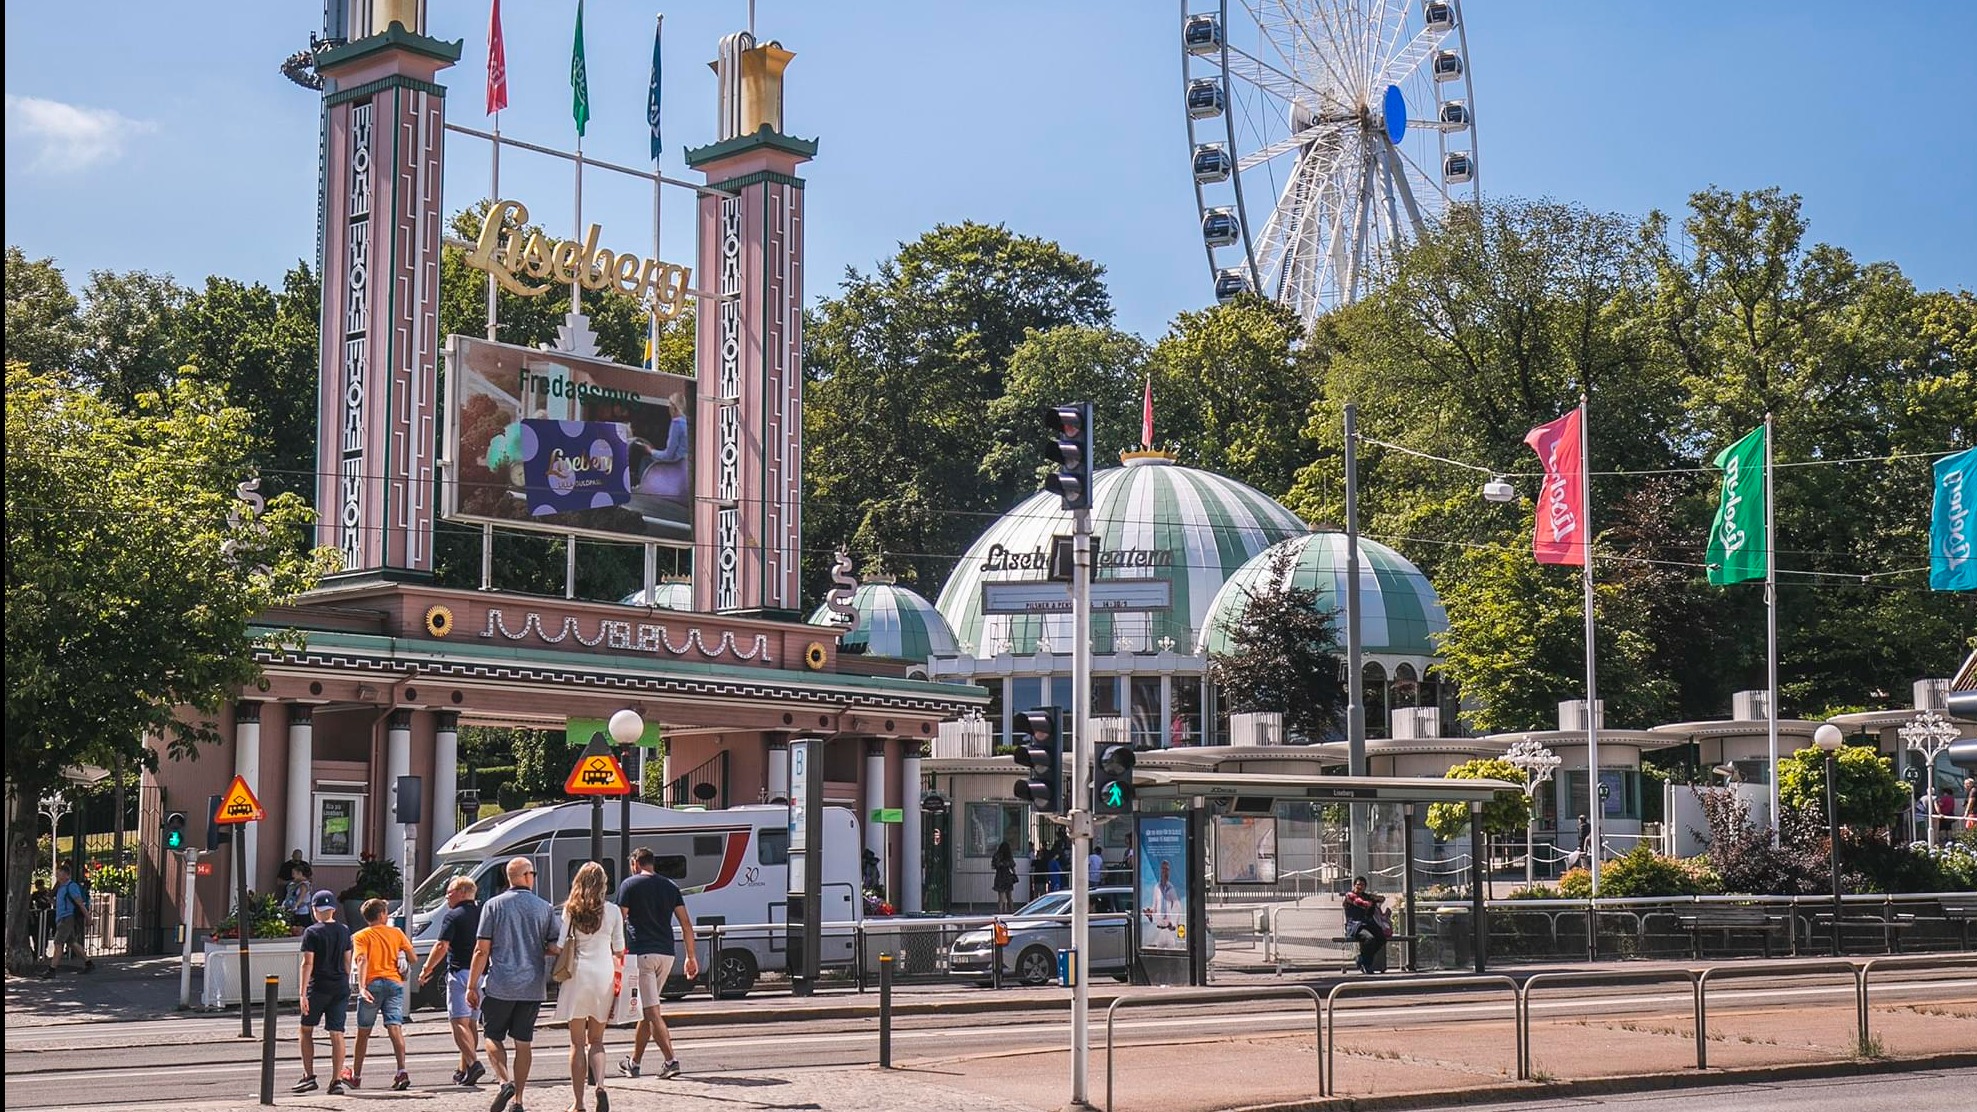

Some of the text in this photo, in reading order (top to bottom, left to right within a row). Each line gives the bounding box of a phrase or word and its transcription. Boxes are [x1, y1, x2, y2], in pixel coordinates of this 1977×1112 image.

[465, 200, 692, 321] Liseberg
[520, 367, 641, 407] Fredagsmys
[796, 750, 803, 775] B
[1333, 789, 1354, 797] Liseberg
